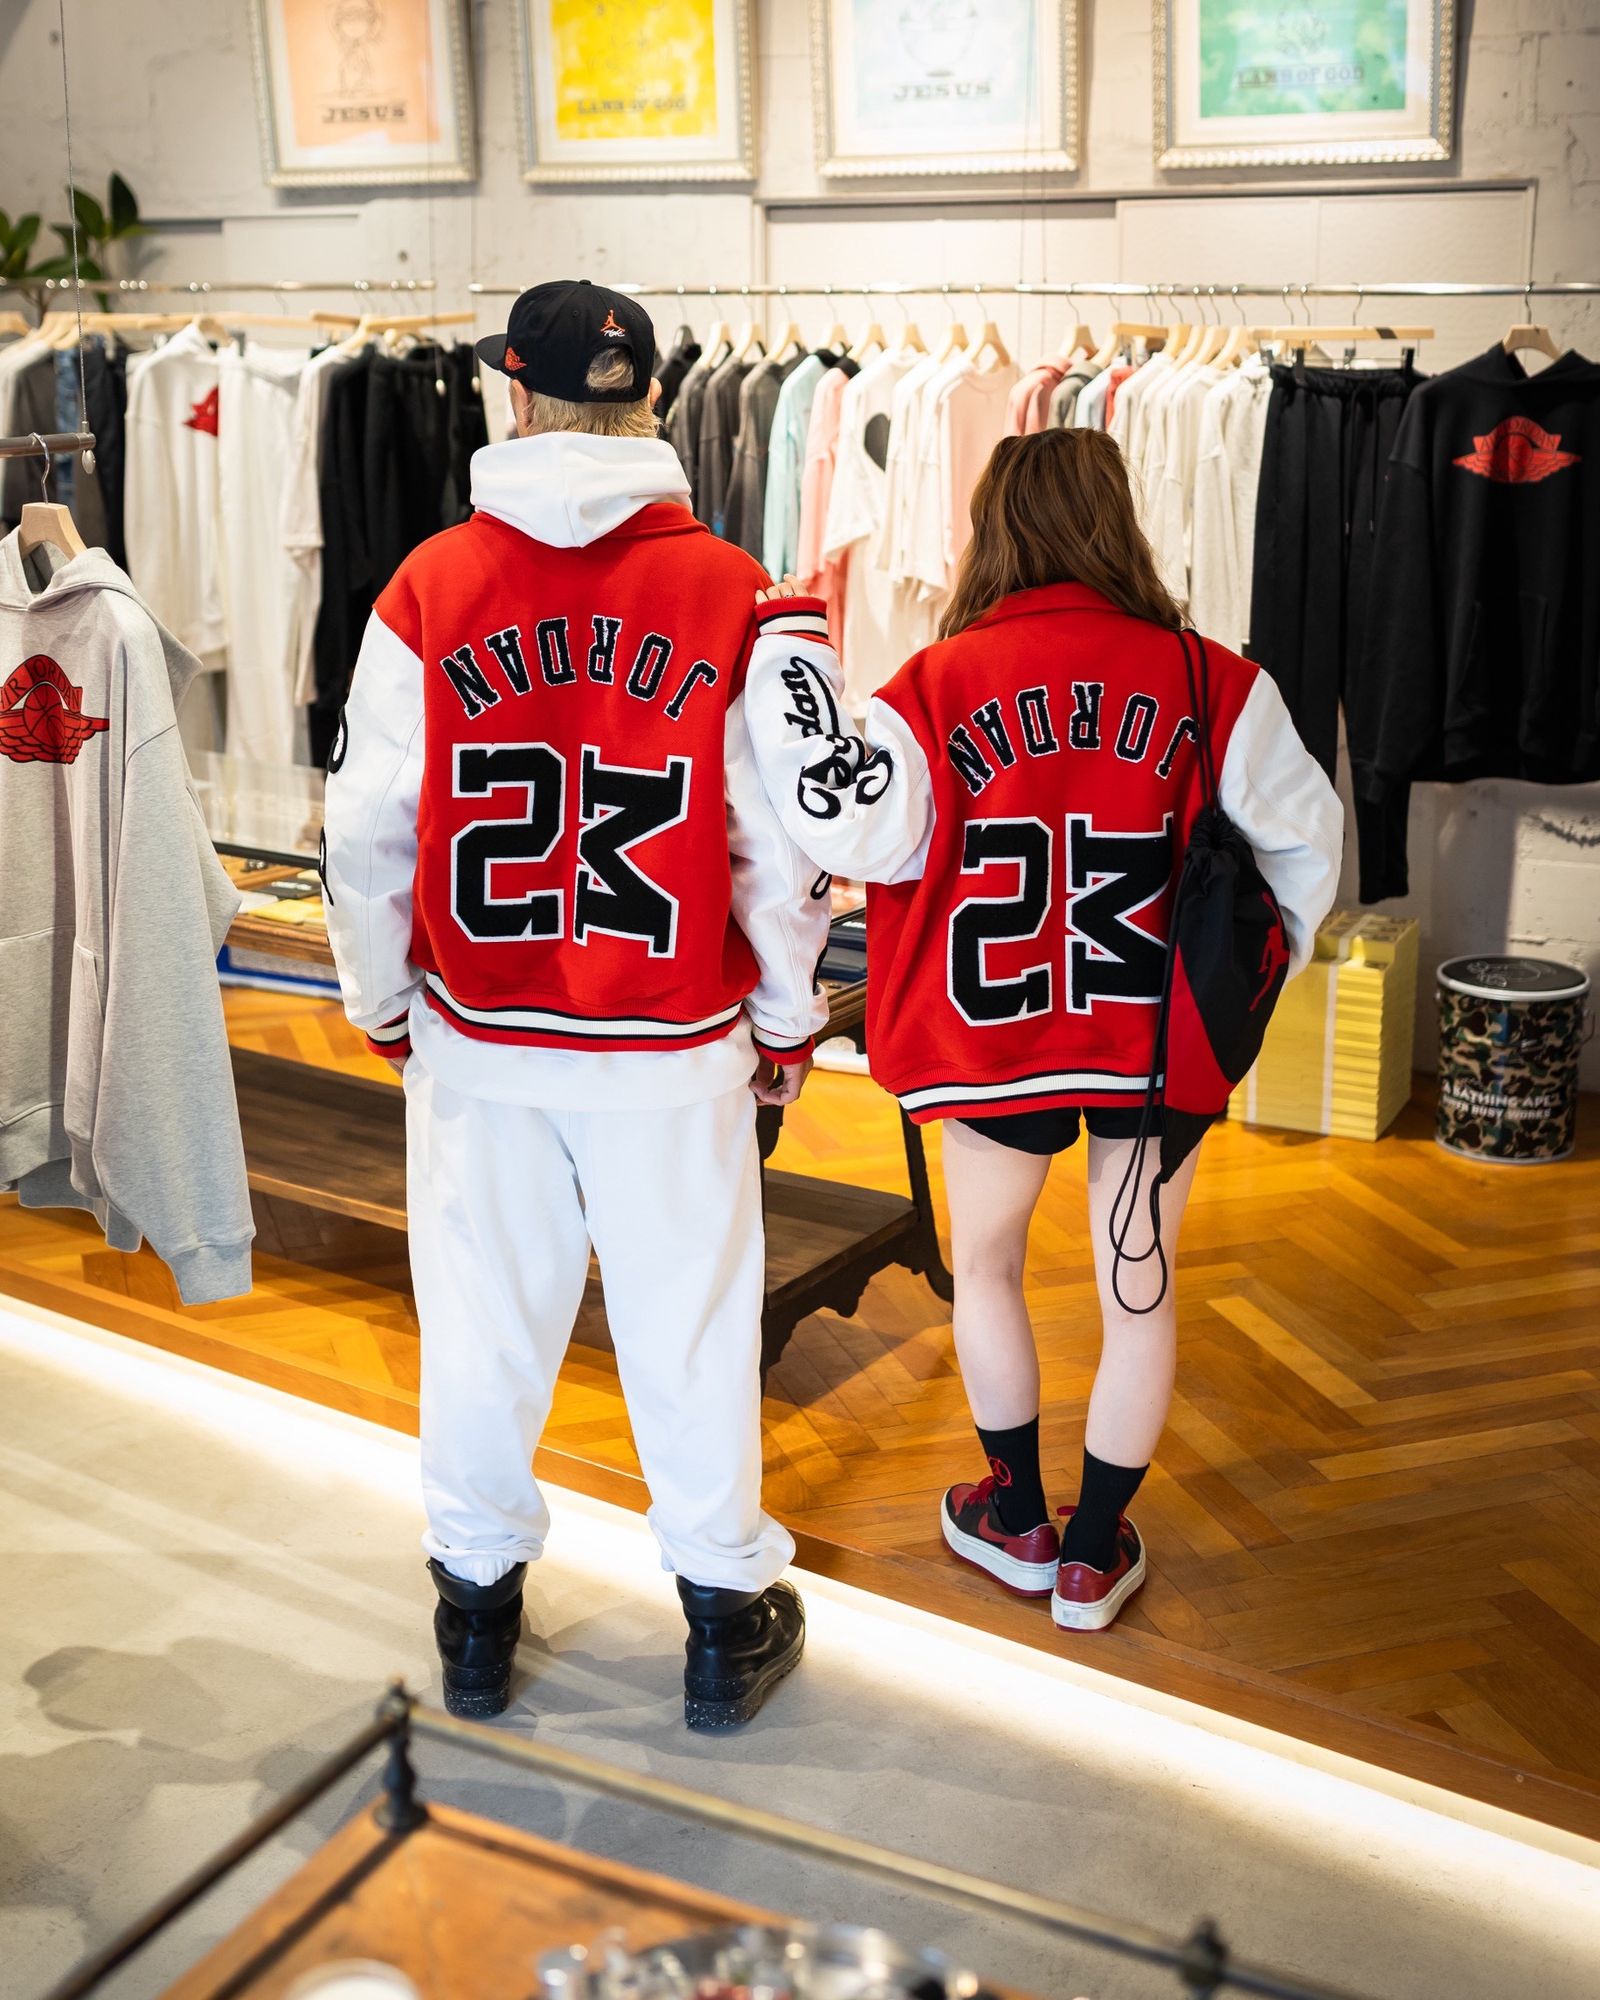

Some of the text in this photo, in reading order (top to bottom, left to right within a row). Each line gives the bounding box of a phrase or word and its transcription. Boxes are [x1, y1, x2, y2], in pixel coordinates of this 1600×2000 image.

[1325, 63, 1365, 82] GOD
[893, 80, 991, 101] JESUS
[322, 103, 407, 124] JESUS
[439, 614, 719, 722] JORDAN
[947, 681, 1201, 797] JORDAN
